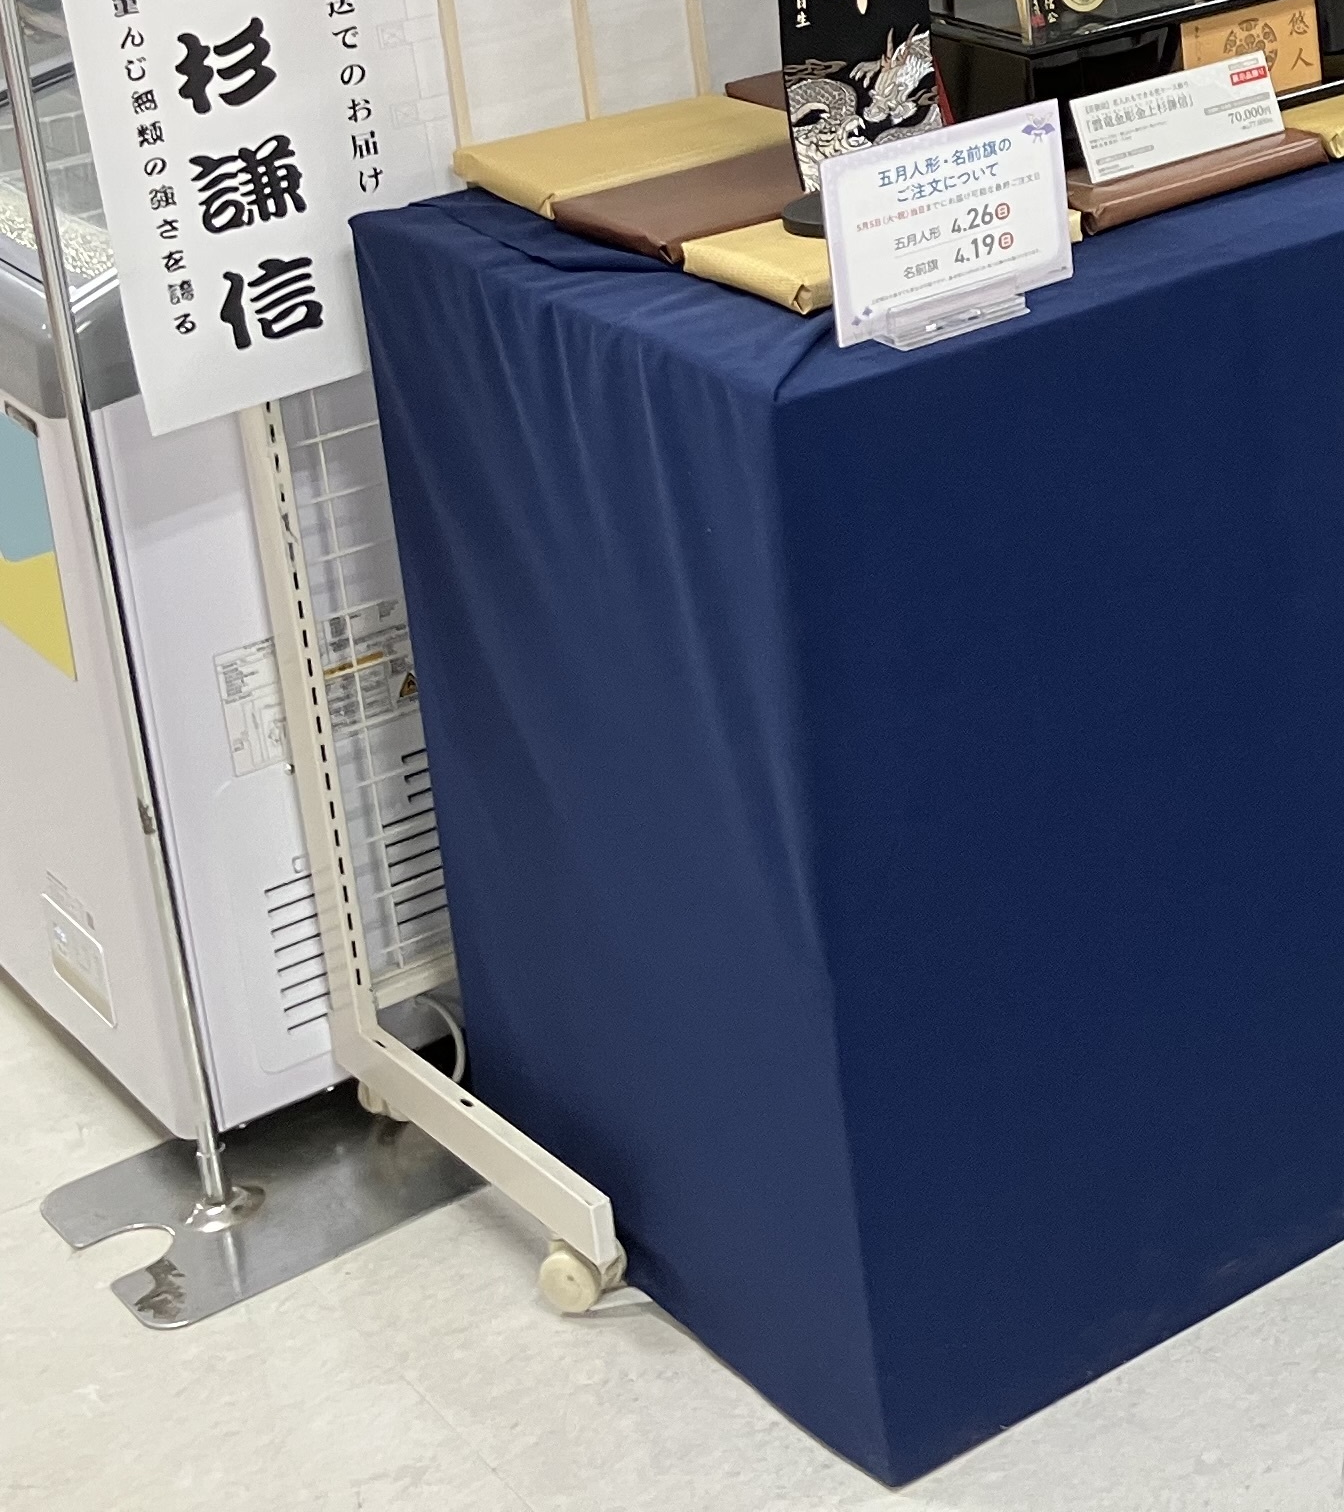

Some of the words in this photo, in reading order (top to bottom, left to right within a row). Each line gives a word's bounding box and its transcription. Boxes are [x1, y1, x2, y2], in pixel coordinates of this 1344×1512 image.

[1287, 9, 1315, 71] 悠人
[877, 137, 1013, 188] 五月人形・名前旗の
[896, 161, 1000, 203] ご注文について
[894, 226, 942, 252] 五月人形
[950, 203, 995, 235] 4.26
[903, 258, 939, 280] 名前旗
[953, 233, 996, 265] 4.19
